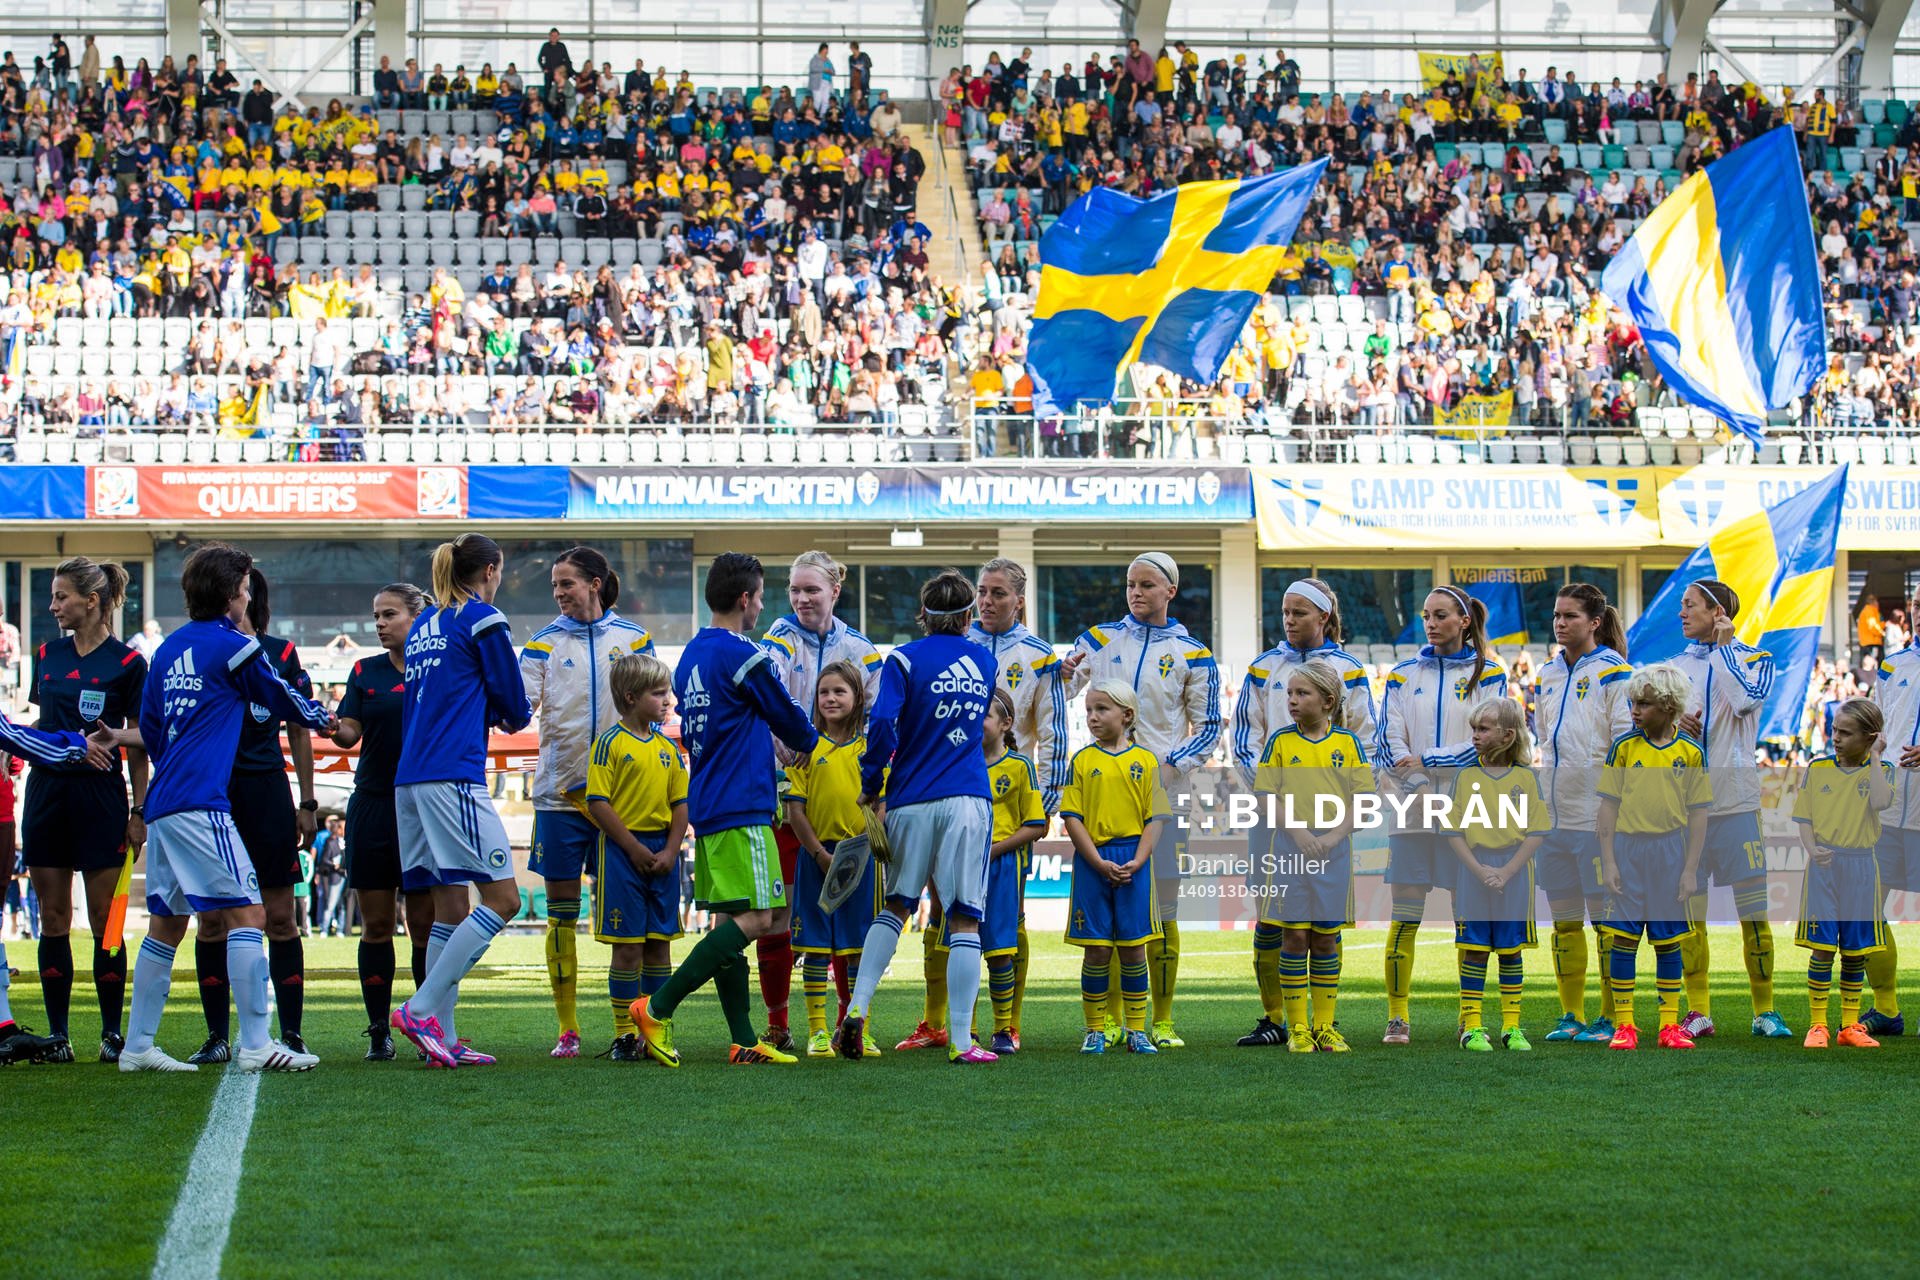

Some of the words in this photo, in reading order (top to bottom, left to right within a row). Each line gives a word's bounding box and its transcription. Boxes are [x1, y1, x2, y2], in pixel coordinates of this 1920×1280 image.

[937, 24, 960, 35] N4
[936, 36, 959, 48] N5
[162, 472, 187, 485] FIFA
[595, 475, 855, 505] NATIONALSPORTEN
[940, 475, 1196, 505] NATIONALSPORTEN
[1351, 478, 1435, 510] CAMP
[1445, 478, 1563, 510] SWEDEN
[1846, 480, 1920, 510] SWED
[197, 485, 357, 517] QUALIFIERS
[1452, 567, 1548, 584] Wallenstam
[405, 635, 447, 657] adidas
[163, 673, 203, 692] adidas
[930, 677, 989, 698] adidas
[81, 701, 100, 711] FIFA
[934, 699, 962, 719] bh
[1743, 841, 1764, 869] 15
